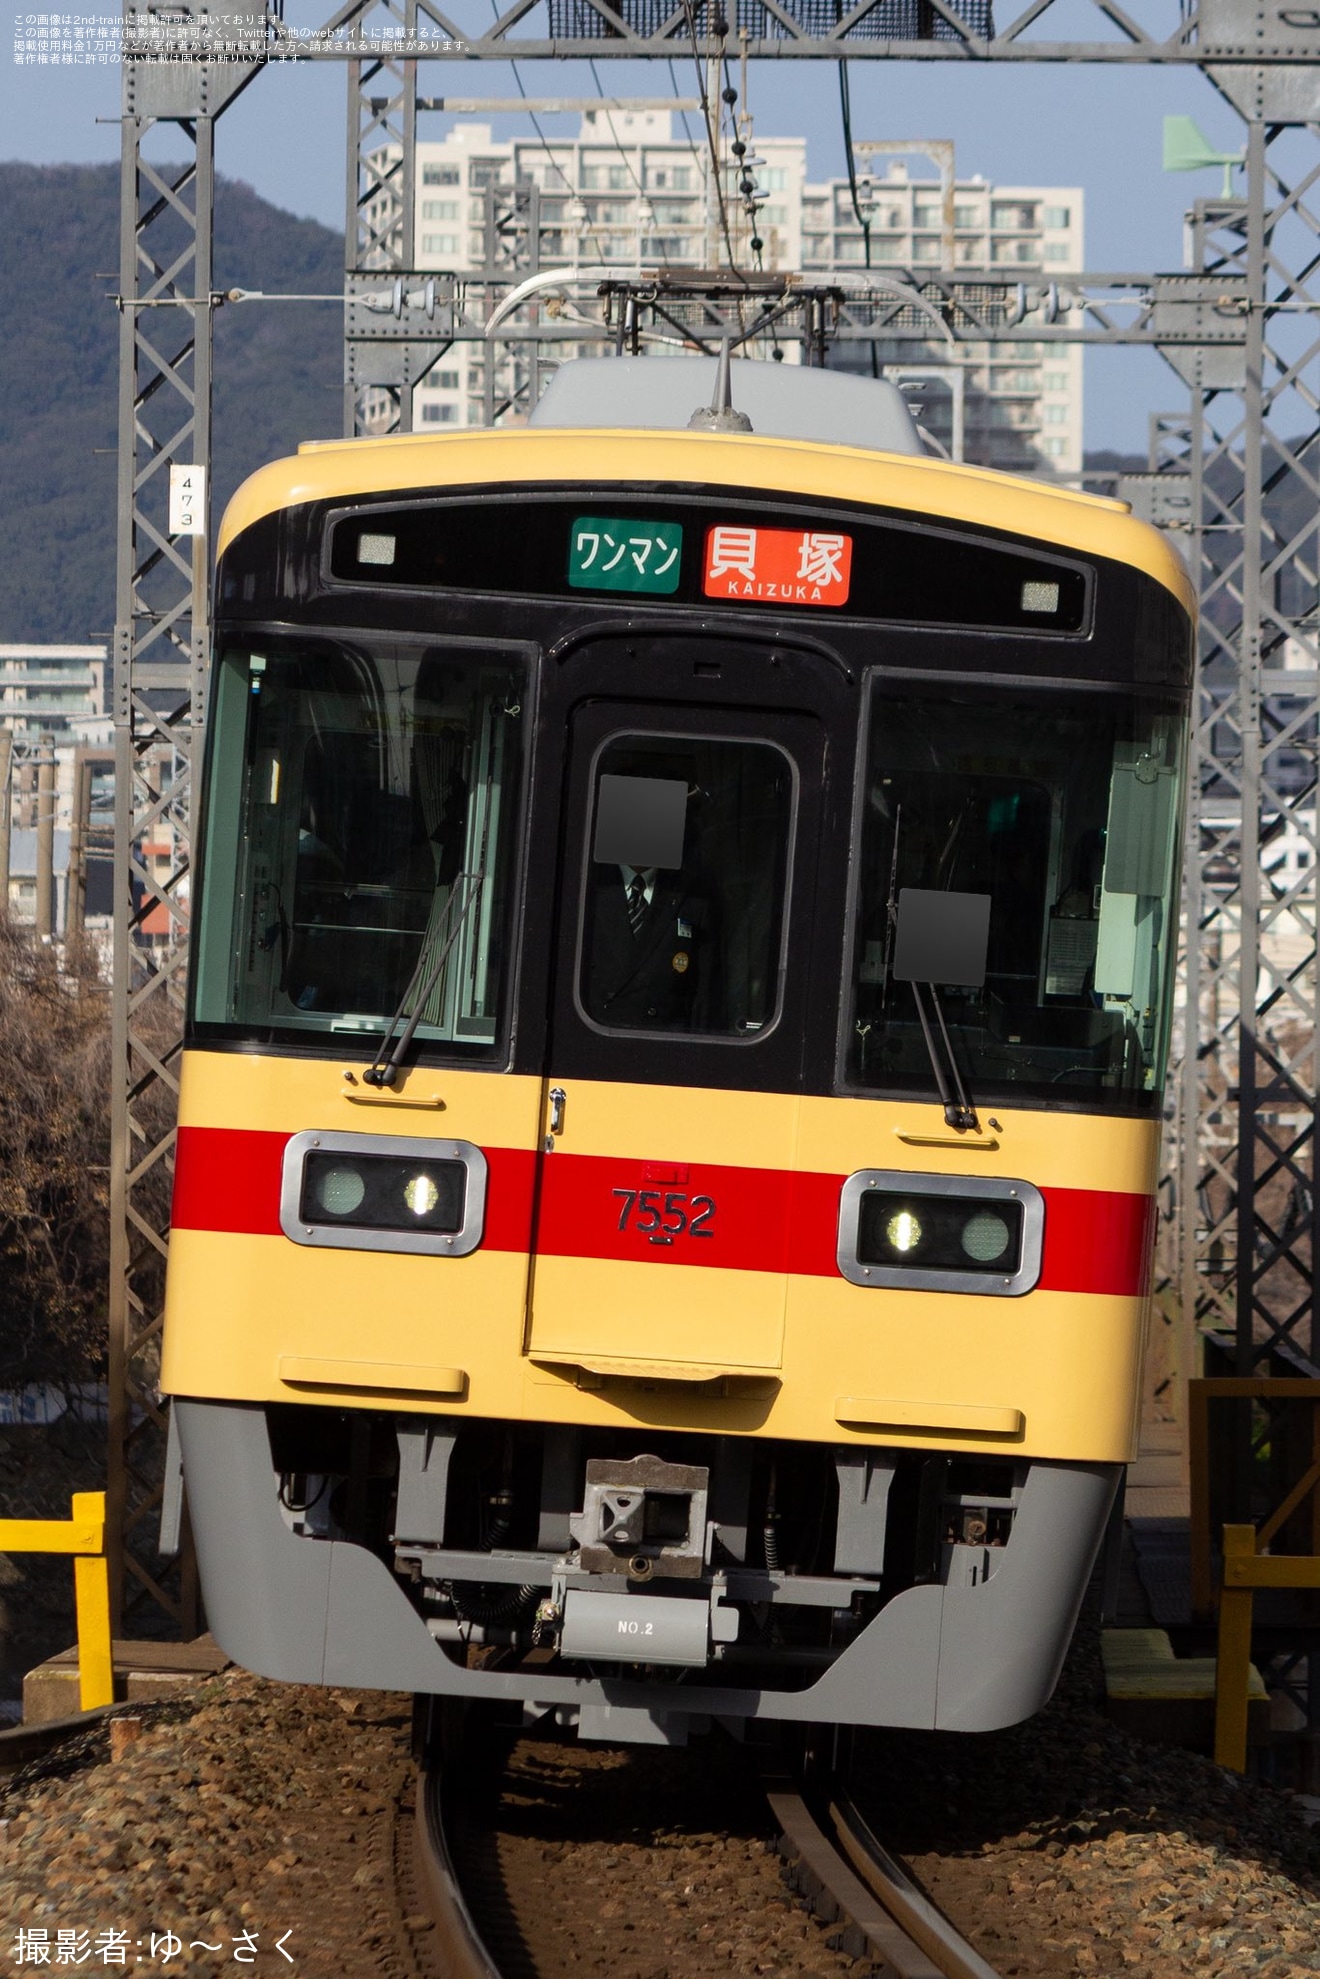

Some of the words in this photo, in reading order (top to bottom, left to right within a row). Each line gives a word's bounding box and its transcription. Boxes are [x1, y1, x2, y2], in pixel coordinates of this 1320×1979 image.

[181, 477, 193, 526] 473
[577, 532, 679, 576] ワンマン
[709, 526, 843, 587] 貝塚
[728, 580, 822, 601] KAIZUKA
[612, 1188, 717, 1238] 7552
[618, 1621, 653, 1635] NO.2
